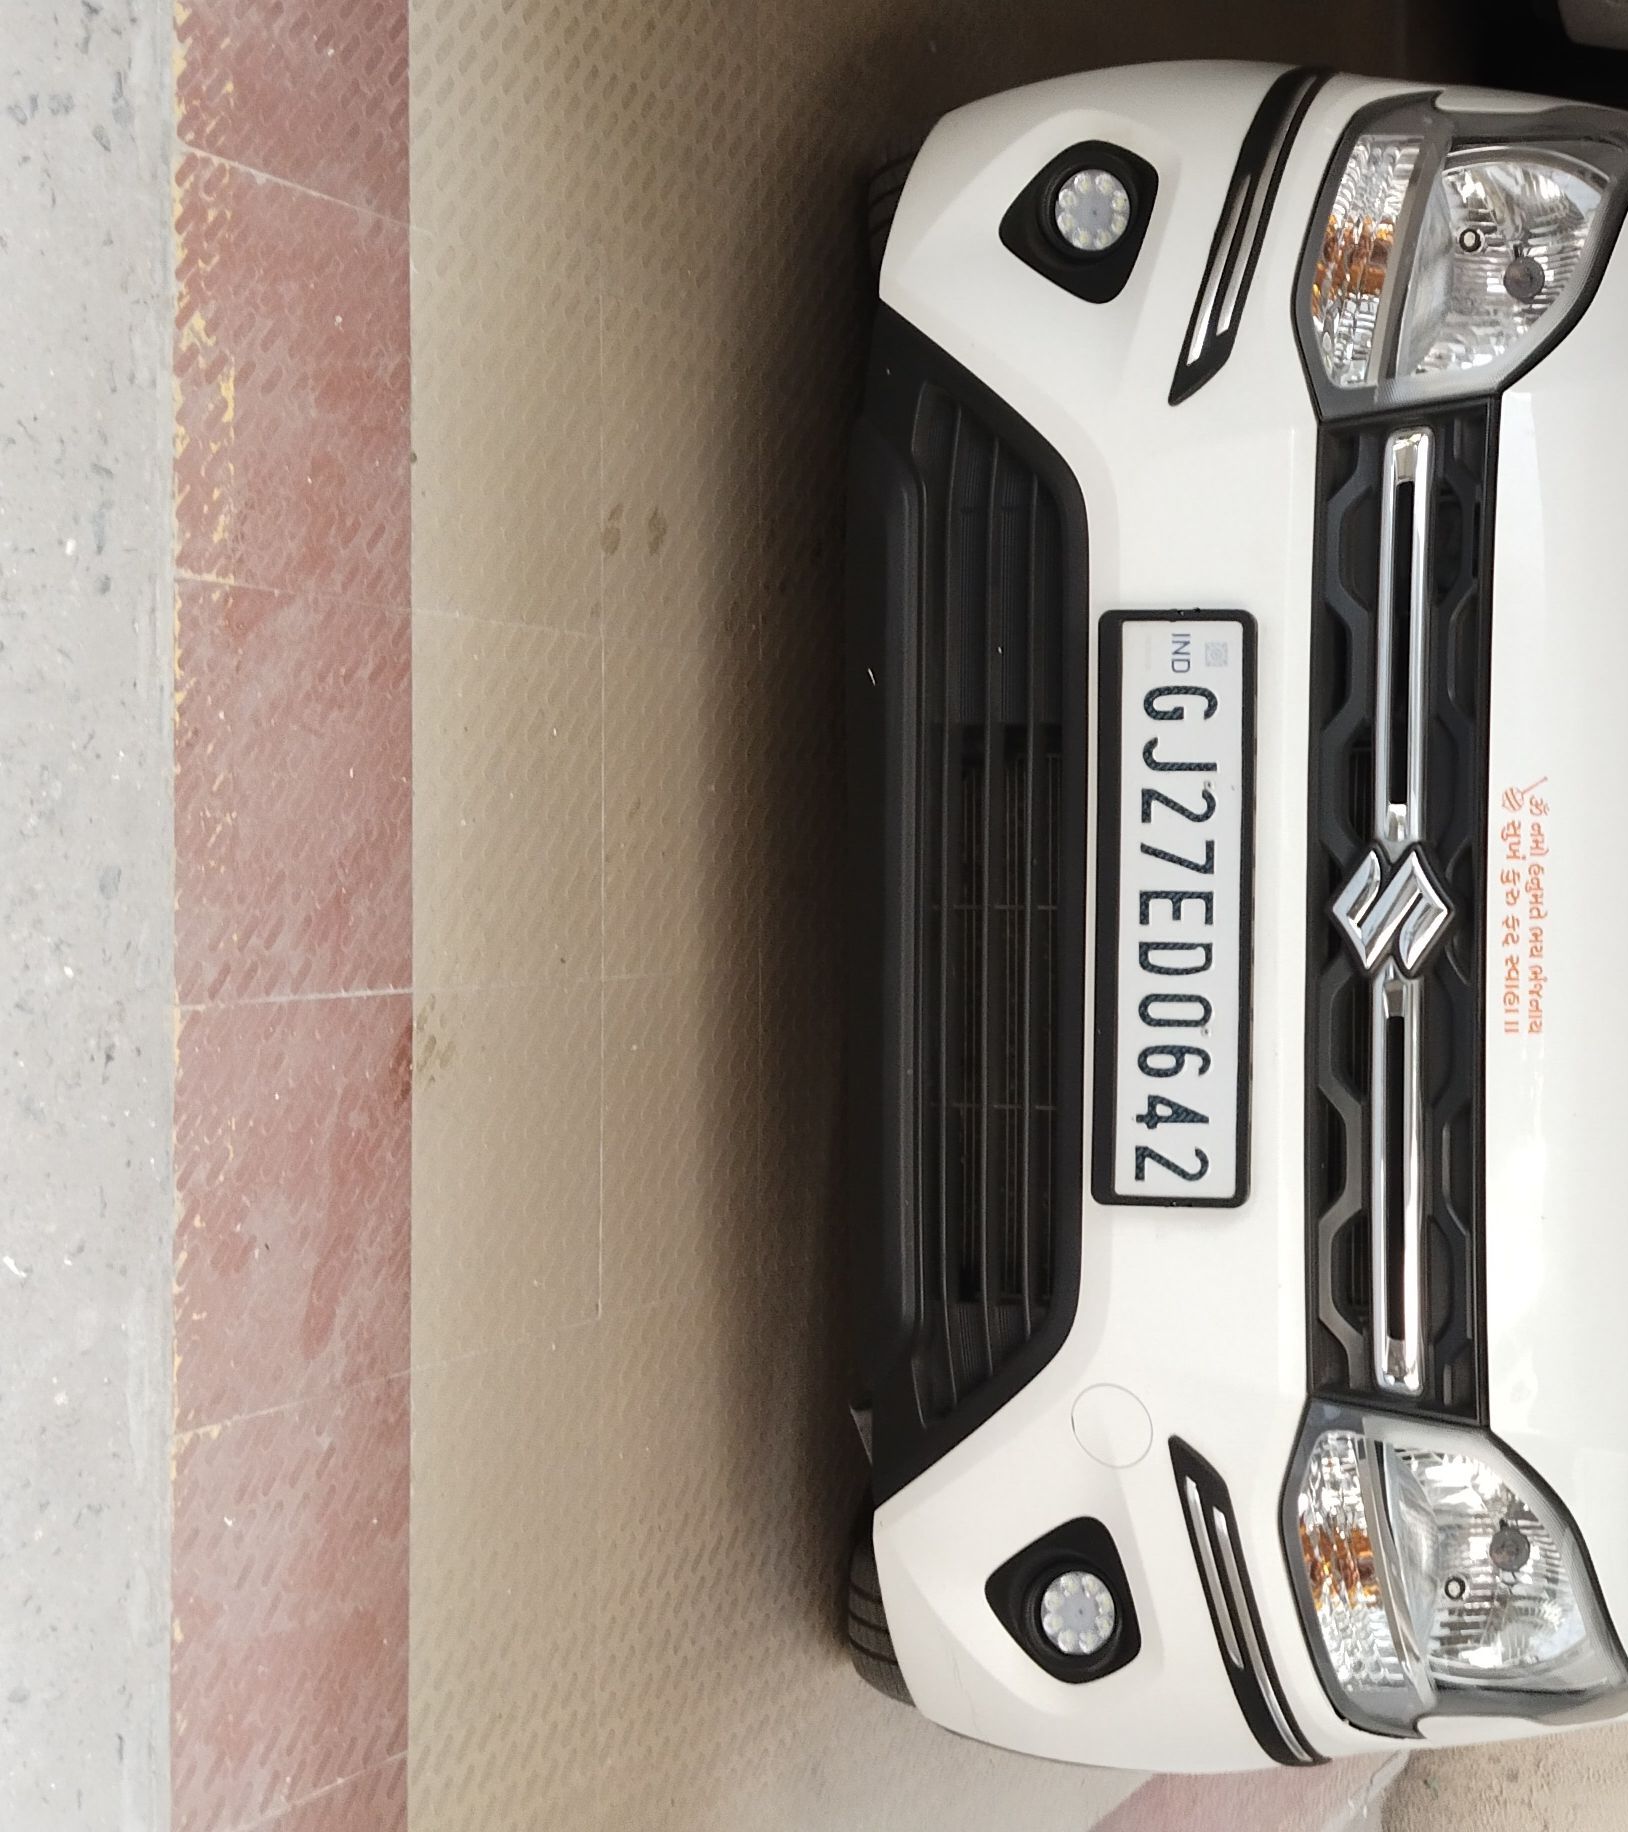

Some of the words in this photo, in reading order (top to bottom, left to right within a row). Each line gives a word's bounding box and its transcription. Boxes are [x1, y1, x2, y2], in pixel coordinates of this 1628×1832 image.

[1170, 632, 1191, 674] IND
[1529, 822, 1549, 857] નમો
[1134, 684, 1219, 1184] GJ27ED0642
[1527, 926, 1543, 959] ભય
